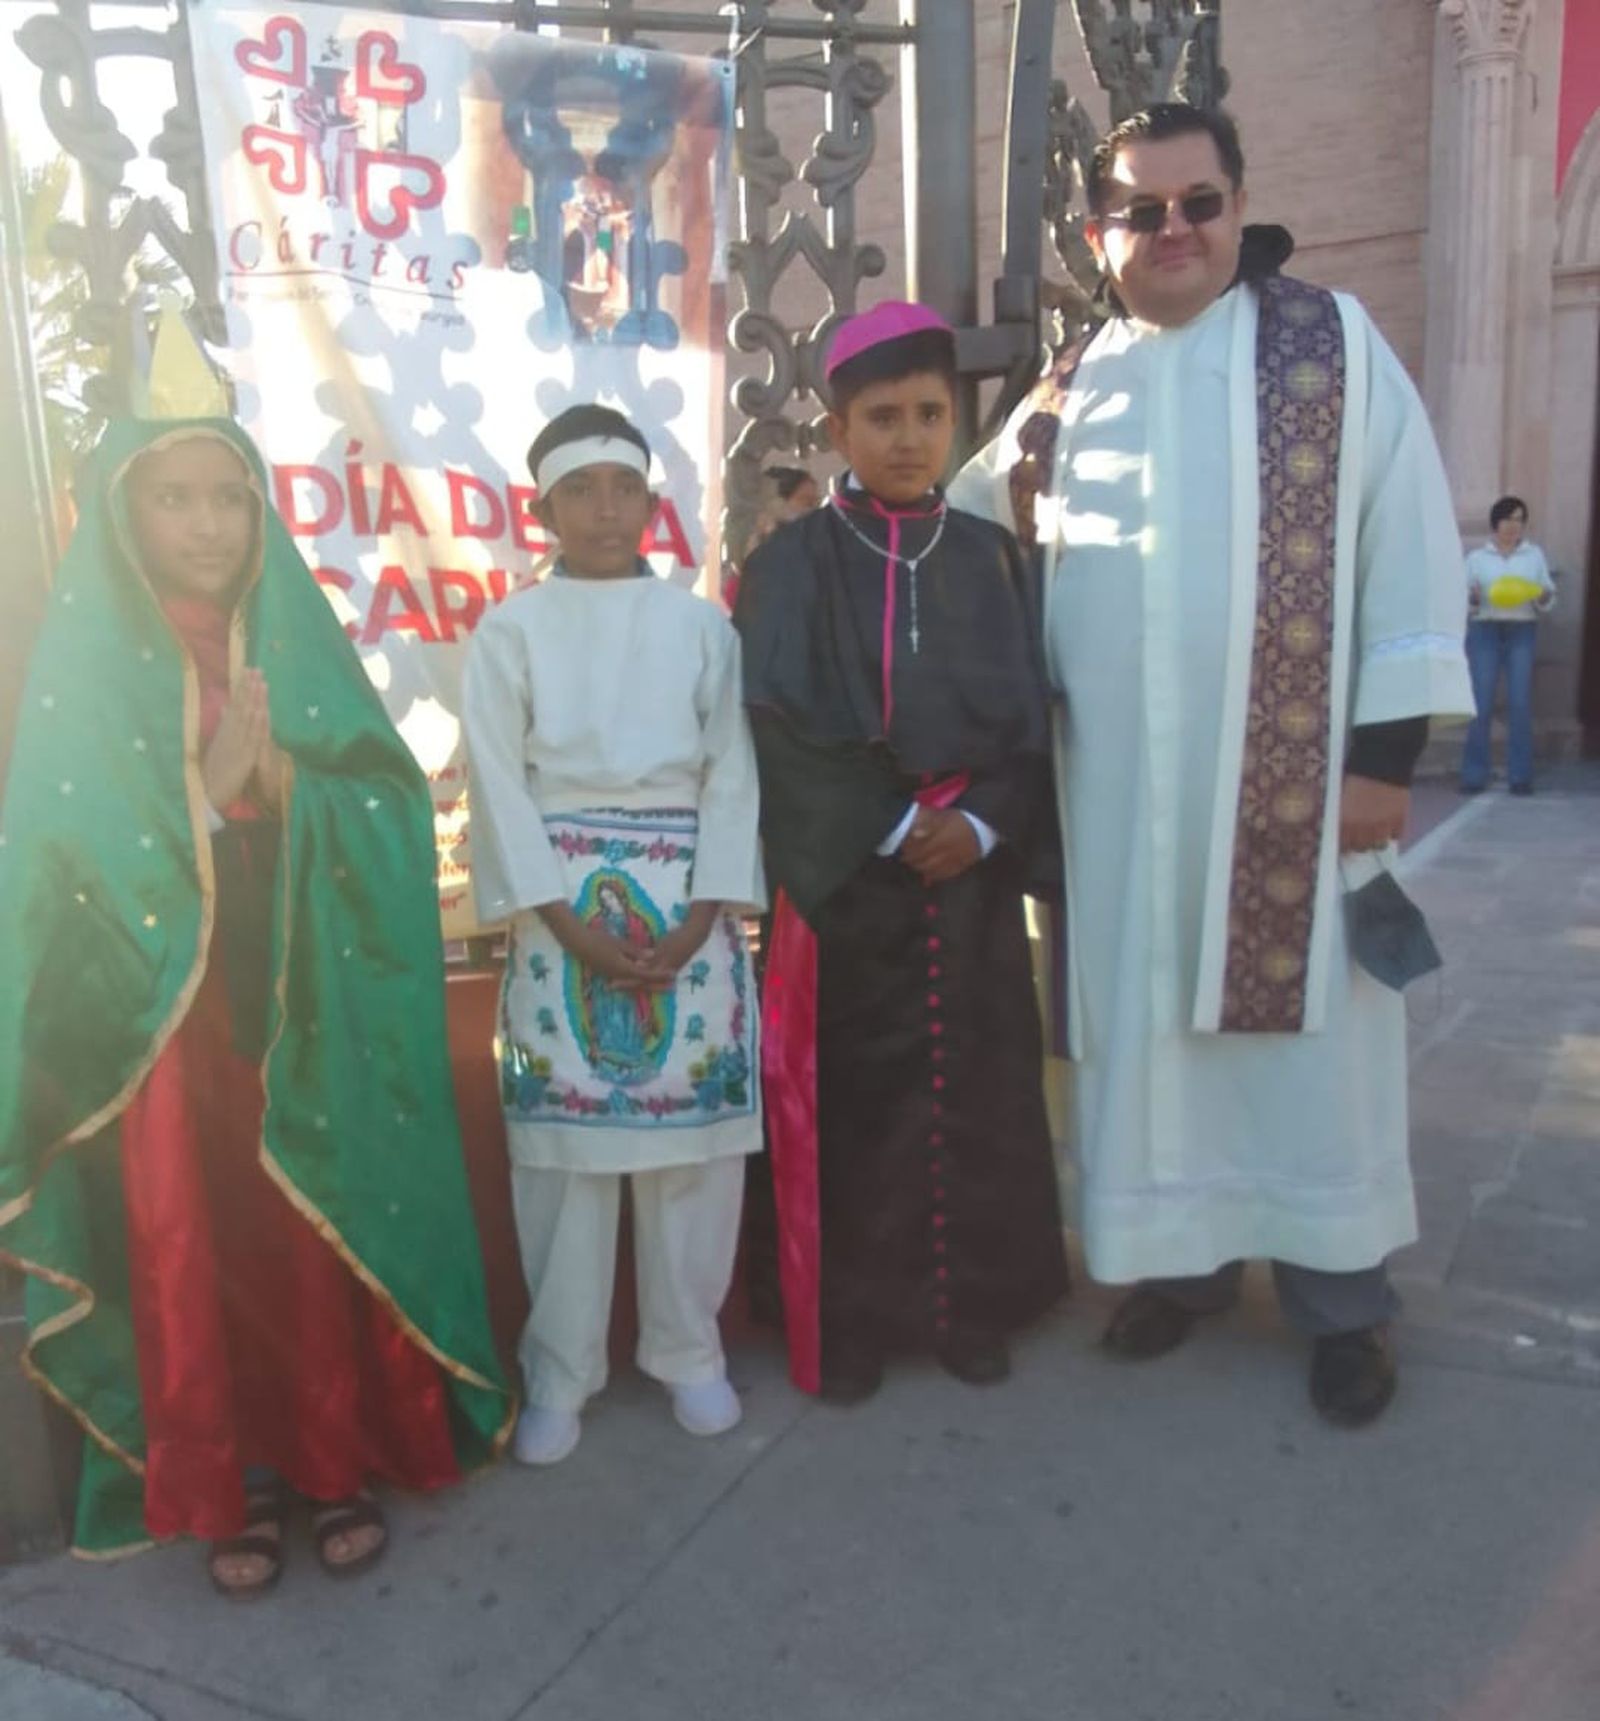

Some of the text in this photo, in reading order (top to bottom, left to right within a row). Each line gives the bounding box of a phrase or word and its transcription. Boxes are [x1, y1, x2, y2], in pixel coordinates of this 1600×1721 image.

[229, 215, 465, 290] Cáritas
[272, 439, 697, 569] DÍA DE A
